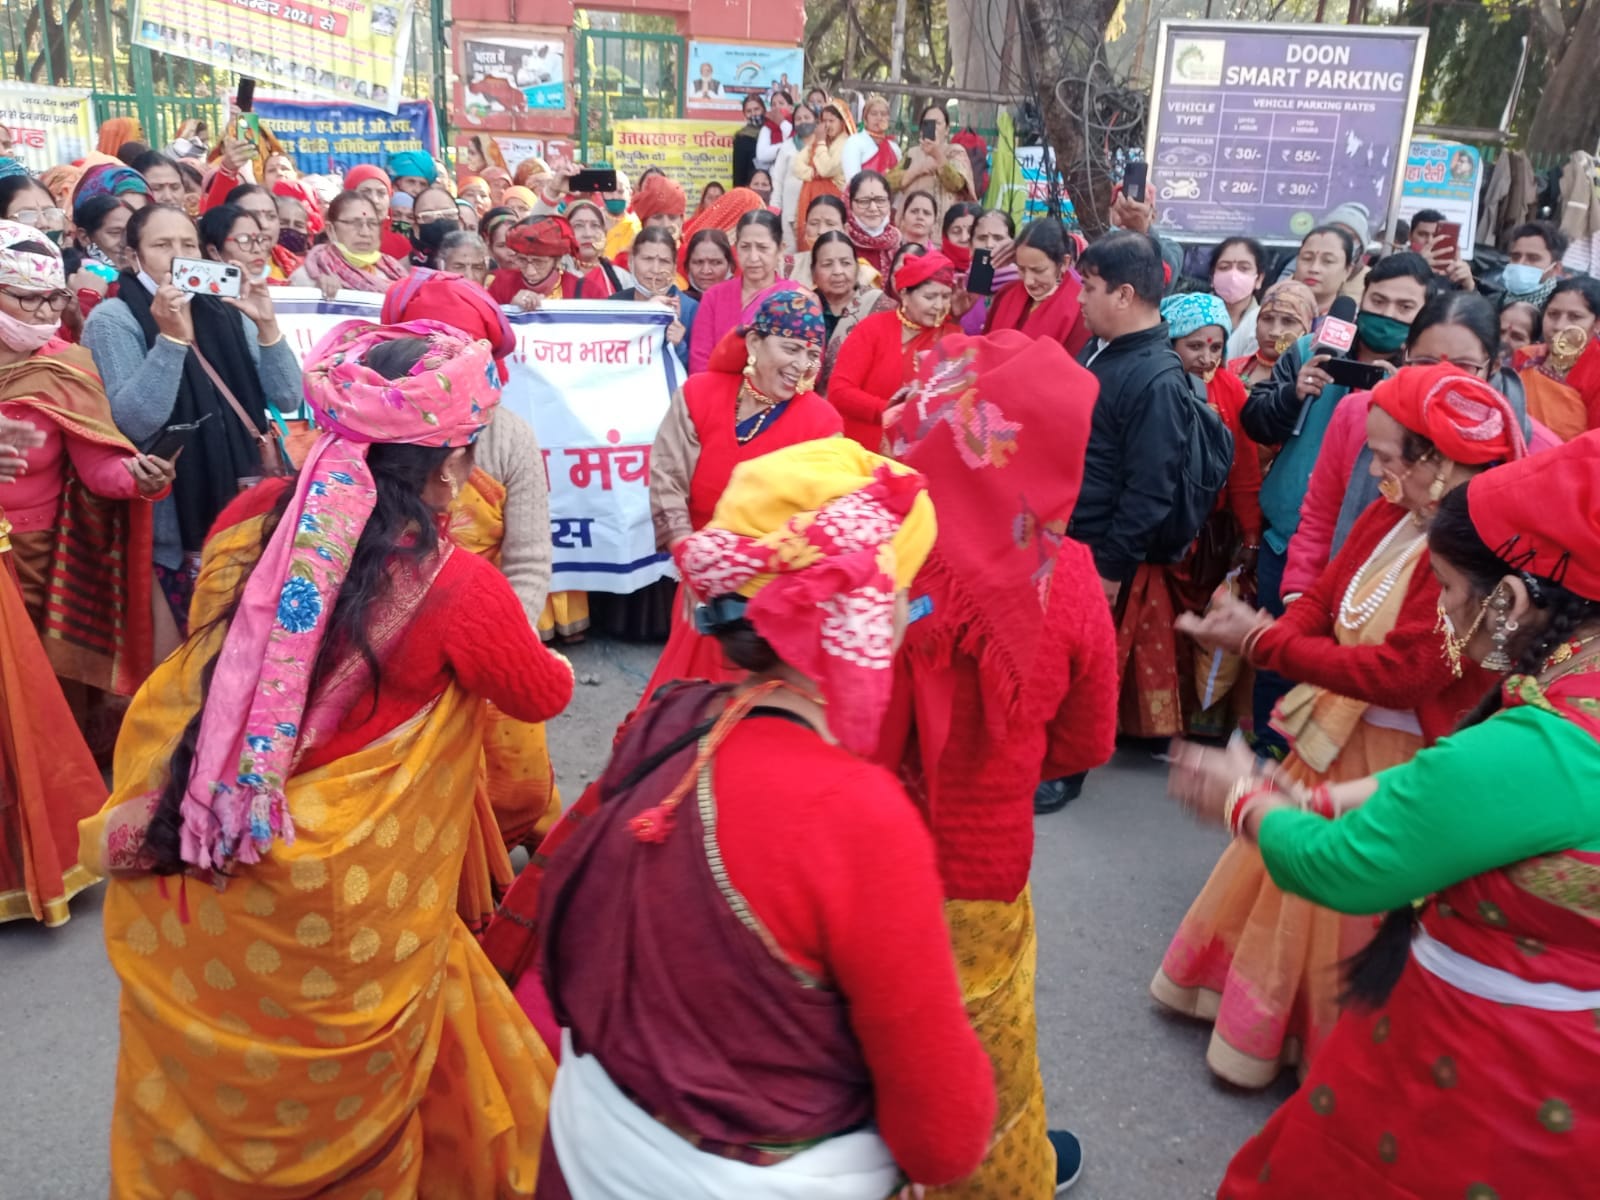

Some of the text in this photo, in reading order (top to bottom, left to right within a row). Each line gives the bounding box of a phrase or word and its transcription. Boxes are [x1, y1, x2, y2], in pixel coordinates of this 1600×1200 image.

[282, 6, 314, 25] 2021
[1286, 43, 1351, 65] DOON
[1225, 65, 1404, 92] SMART PARKING
[1167, 101, 1216, 114] VEHICLE
[1253, 97, 1376, 113] VEHICLE PARKING RATES
[1176, 114, 1205, 126] TYPE
[1235, 147, 1262, 160] 30/-
[1294, 150, 1321, 163] 55/-
[1423, 162, 1445, 182] रैली
[1231, 181, 1258, 194] 20/-
[533, 340, 573, 363] जय
[579, 339, 631, 364] भारत
[563, 428, 653, 491] मंच
